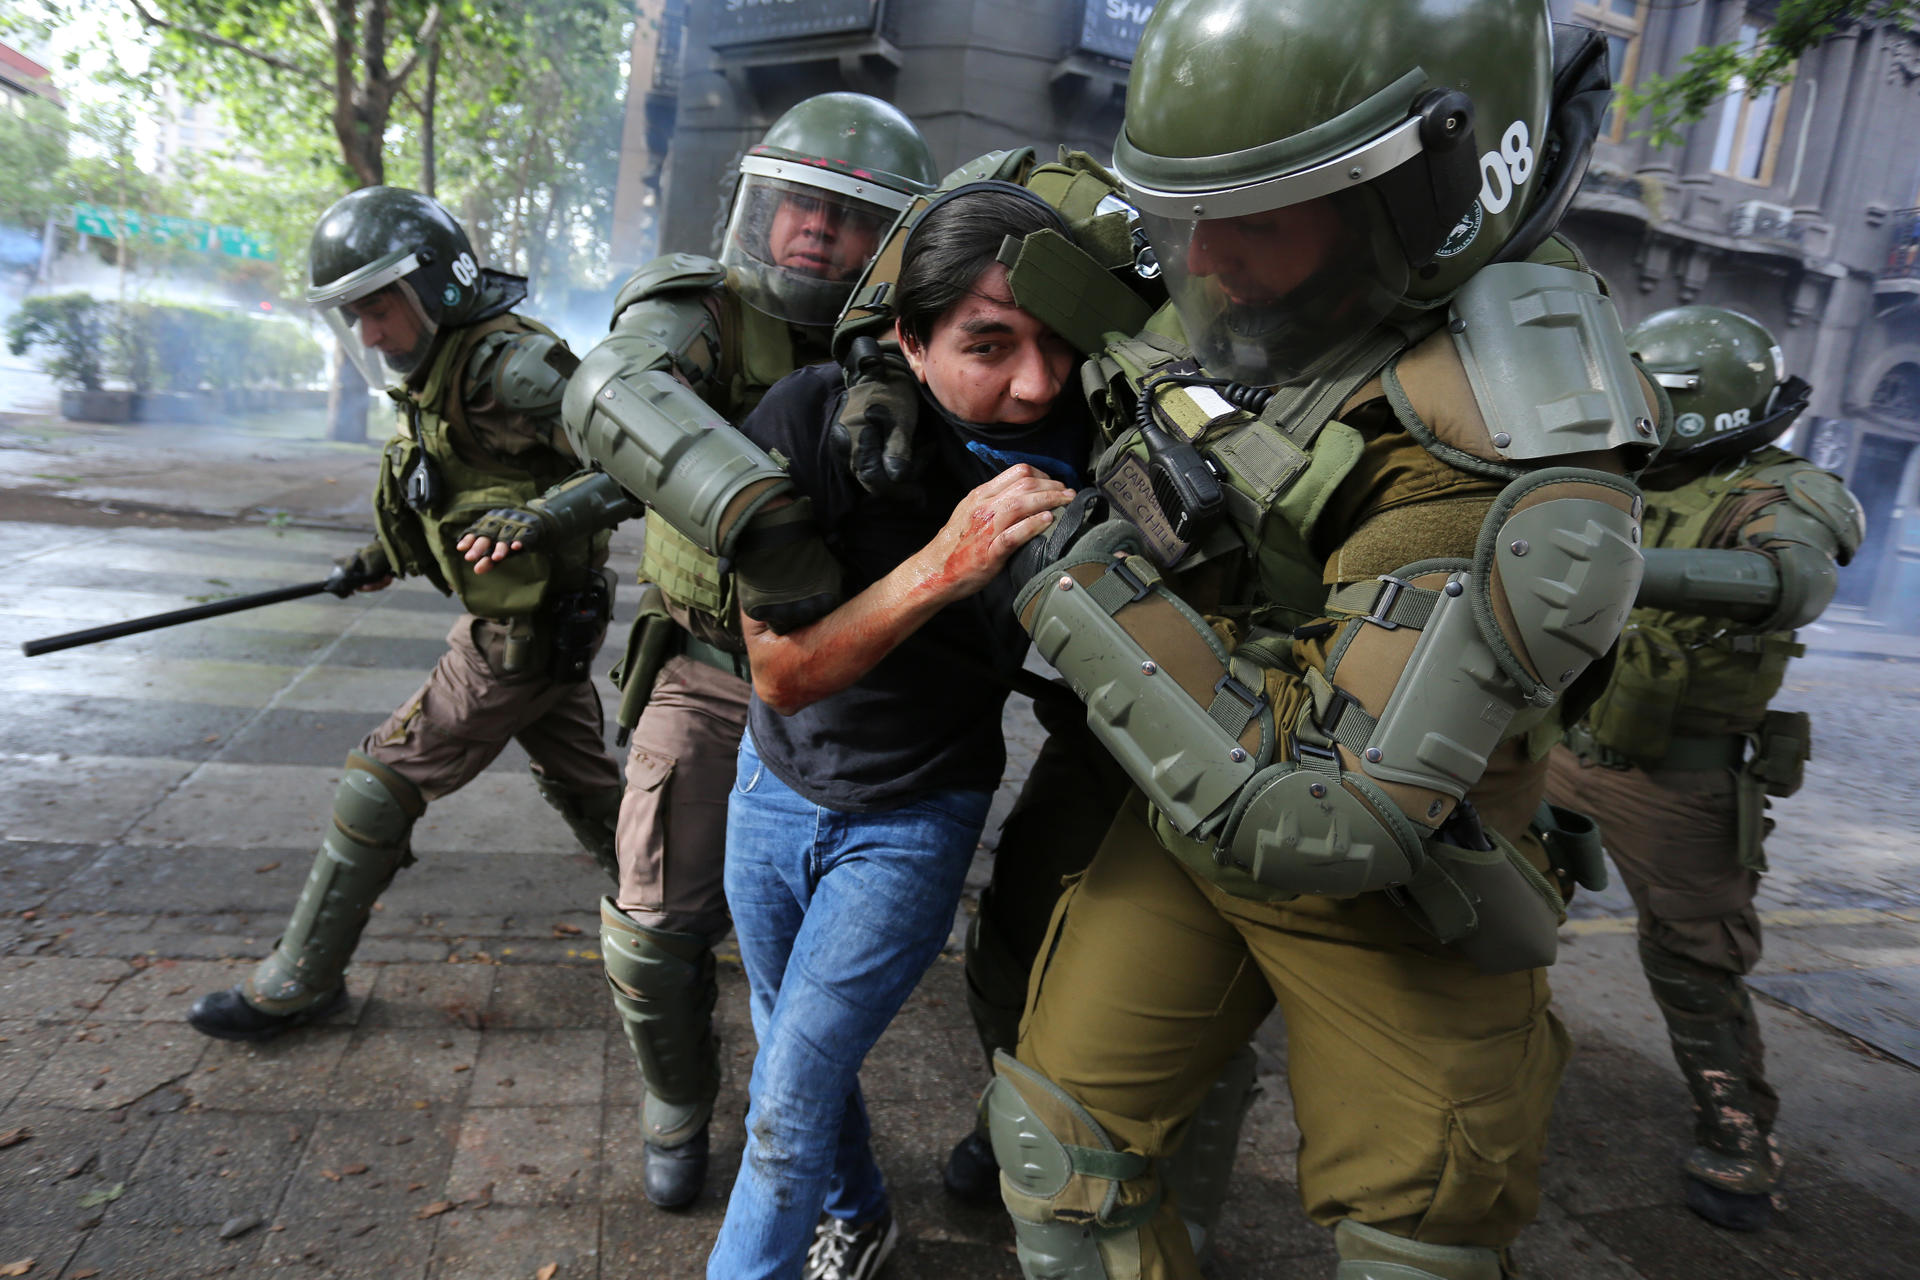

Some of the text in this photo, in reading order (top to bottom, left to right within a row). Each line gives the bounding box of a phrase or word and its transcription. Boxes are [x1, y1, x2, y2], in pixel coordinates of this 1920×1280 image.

[1479, 120, 1534, 214] 08
[451, 252, 479, 287] 09
[1715, 408, 1751, 431] 08
[1112, 481, 1177, 555] de CHILE
